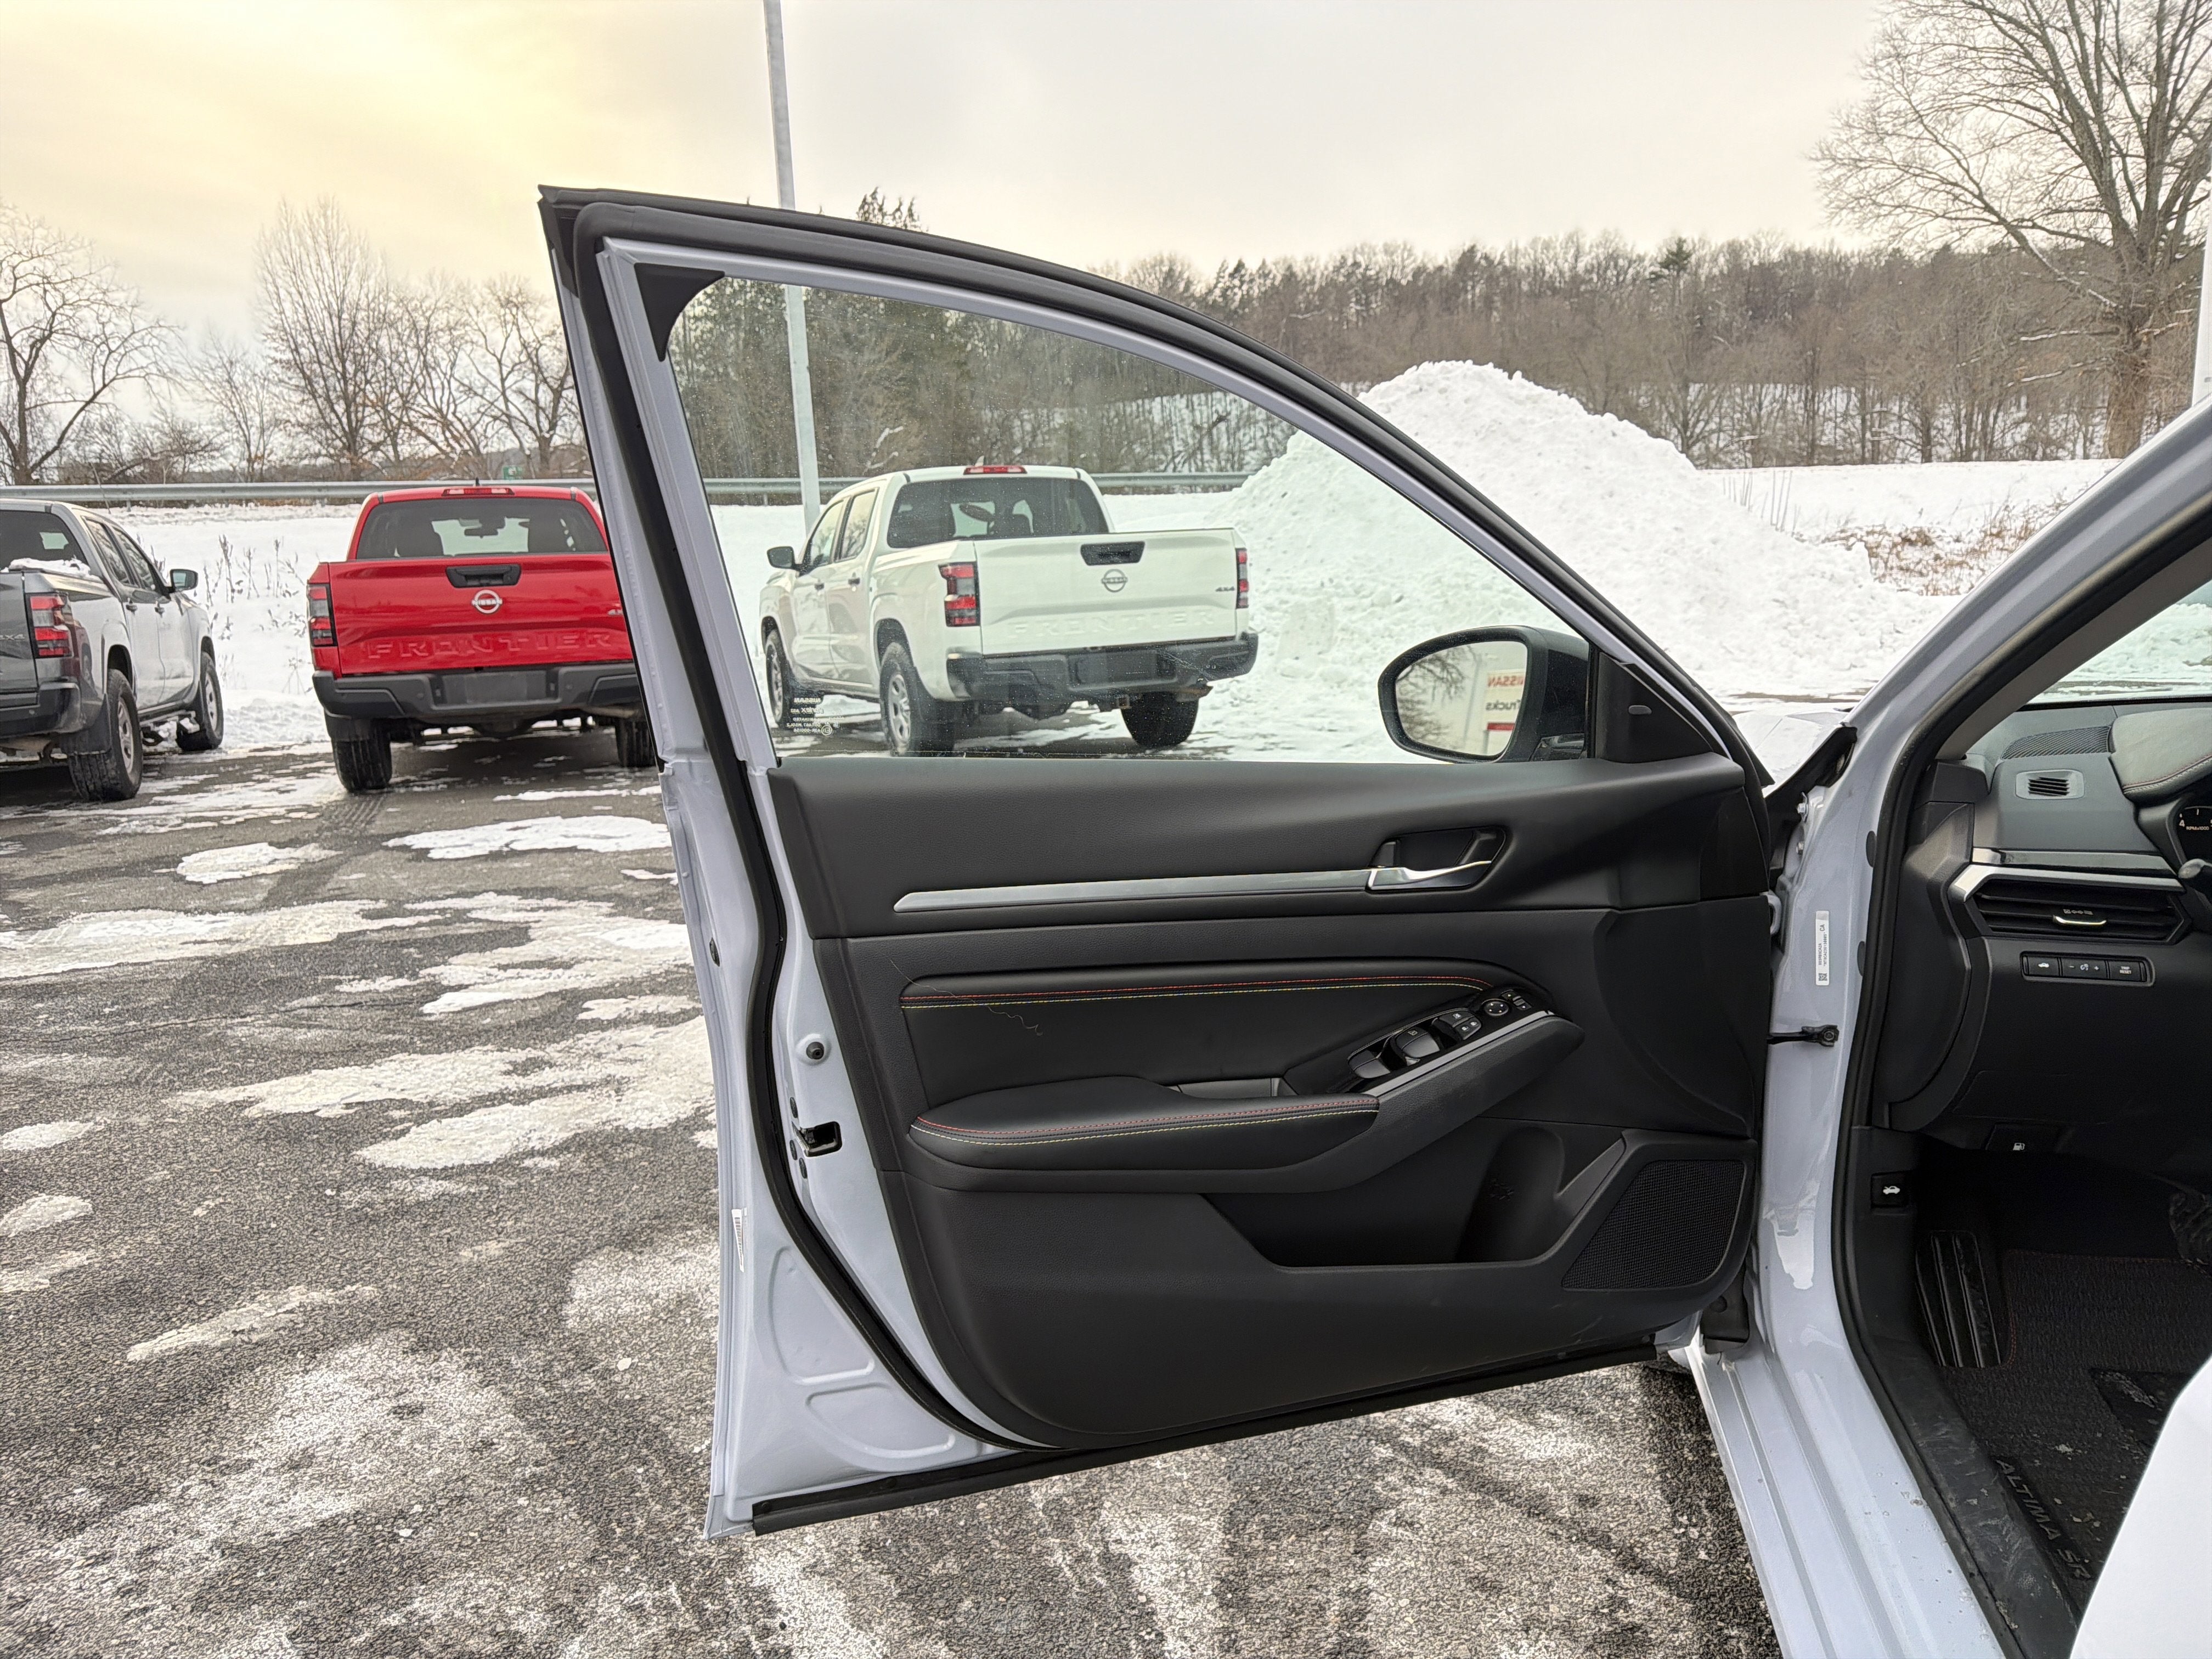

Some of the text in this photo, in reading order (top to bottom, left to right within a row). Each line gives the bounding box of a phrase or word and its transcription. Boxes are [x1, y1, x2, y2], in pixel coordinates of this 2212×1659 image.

[1008, 610, 1215, 639] FRONTIER
[366, 631, 612, 659] FRONTIER
[1996, 1459, 2061, 1541] ALTIMA
